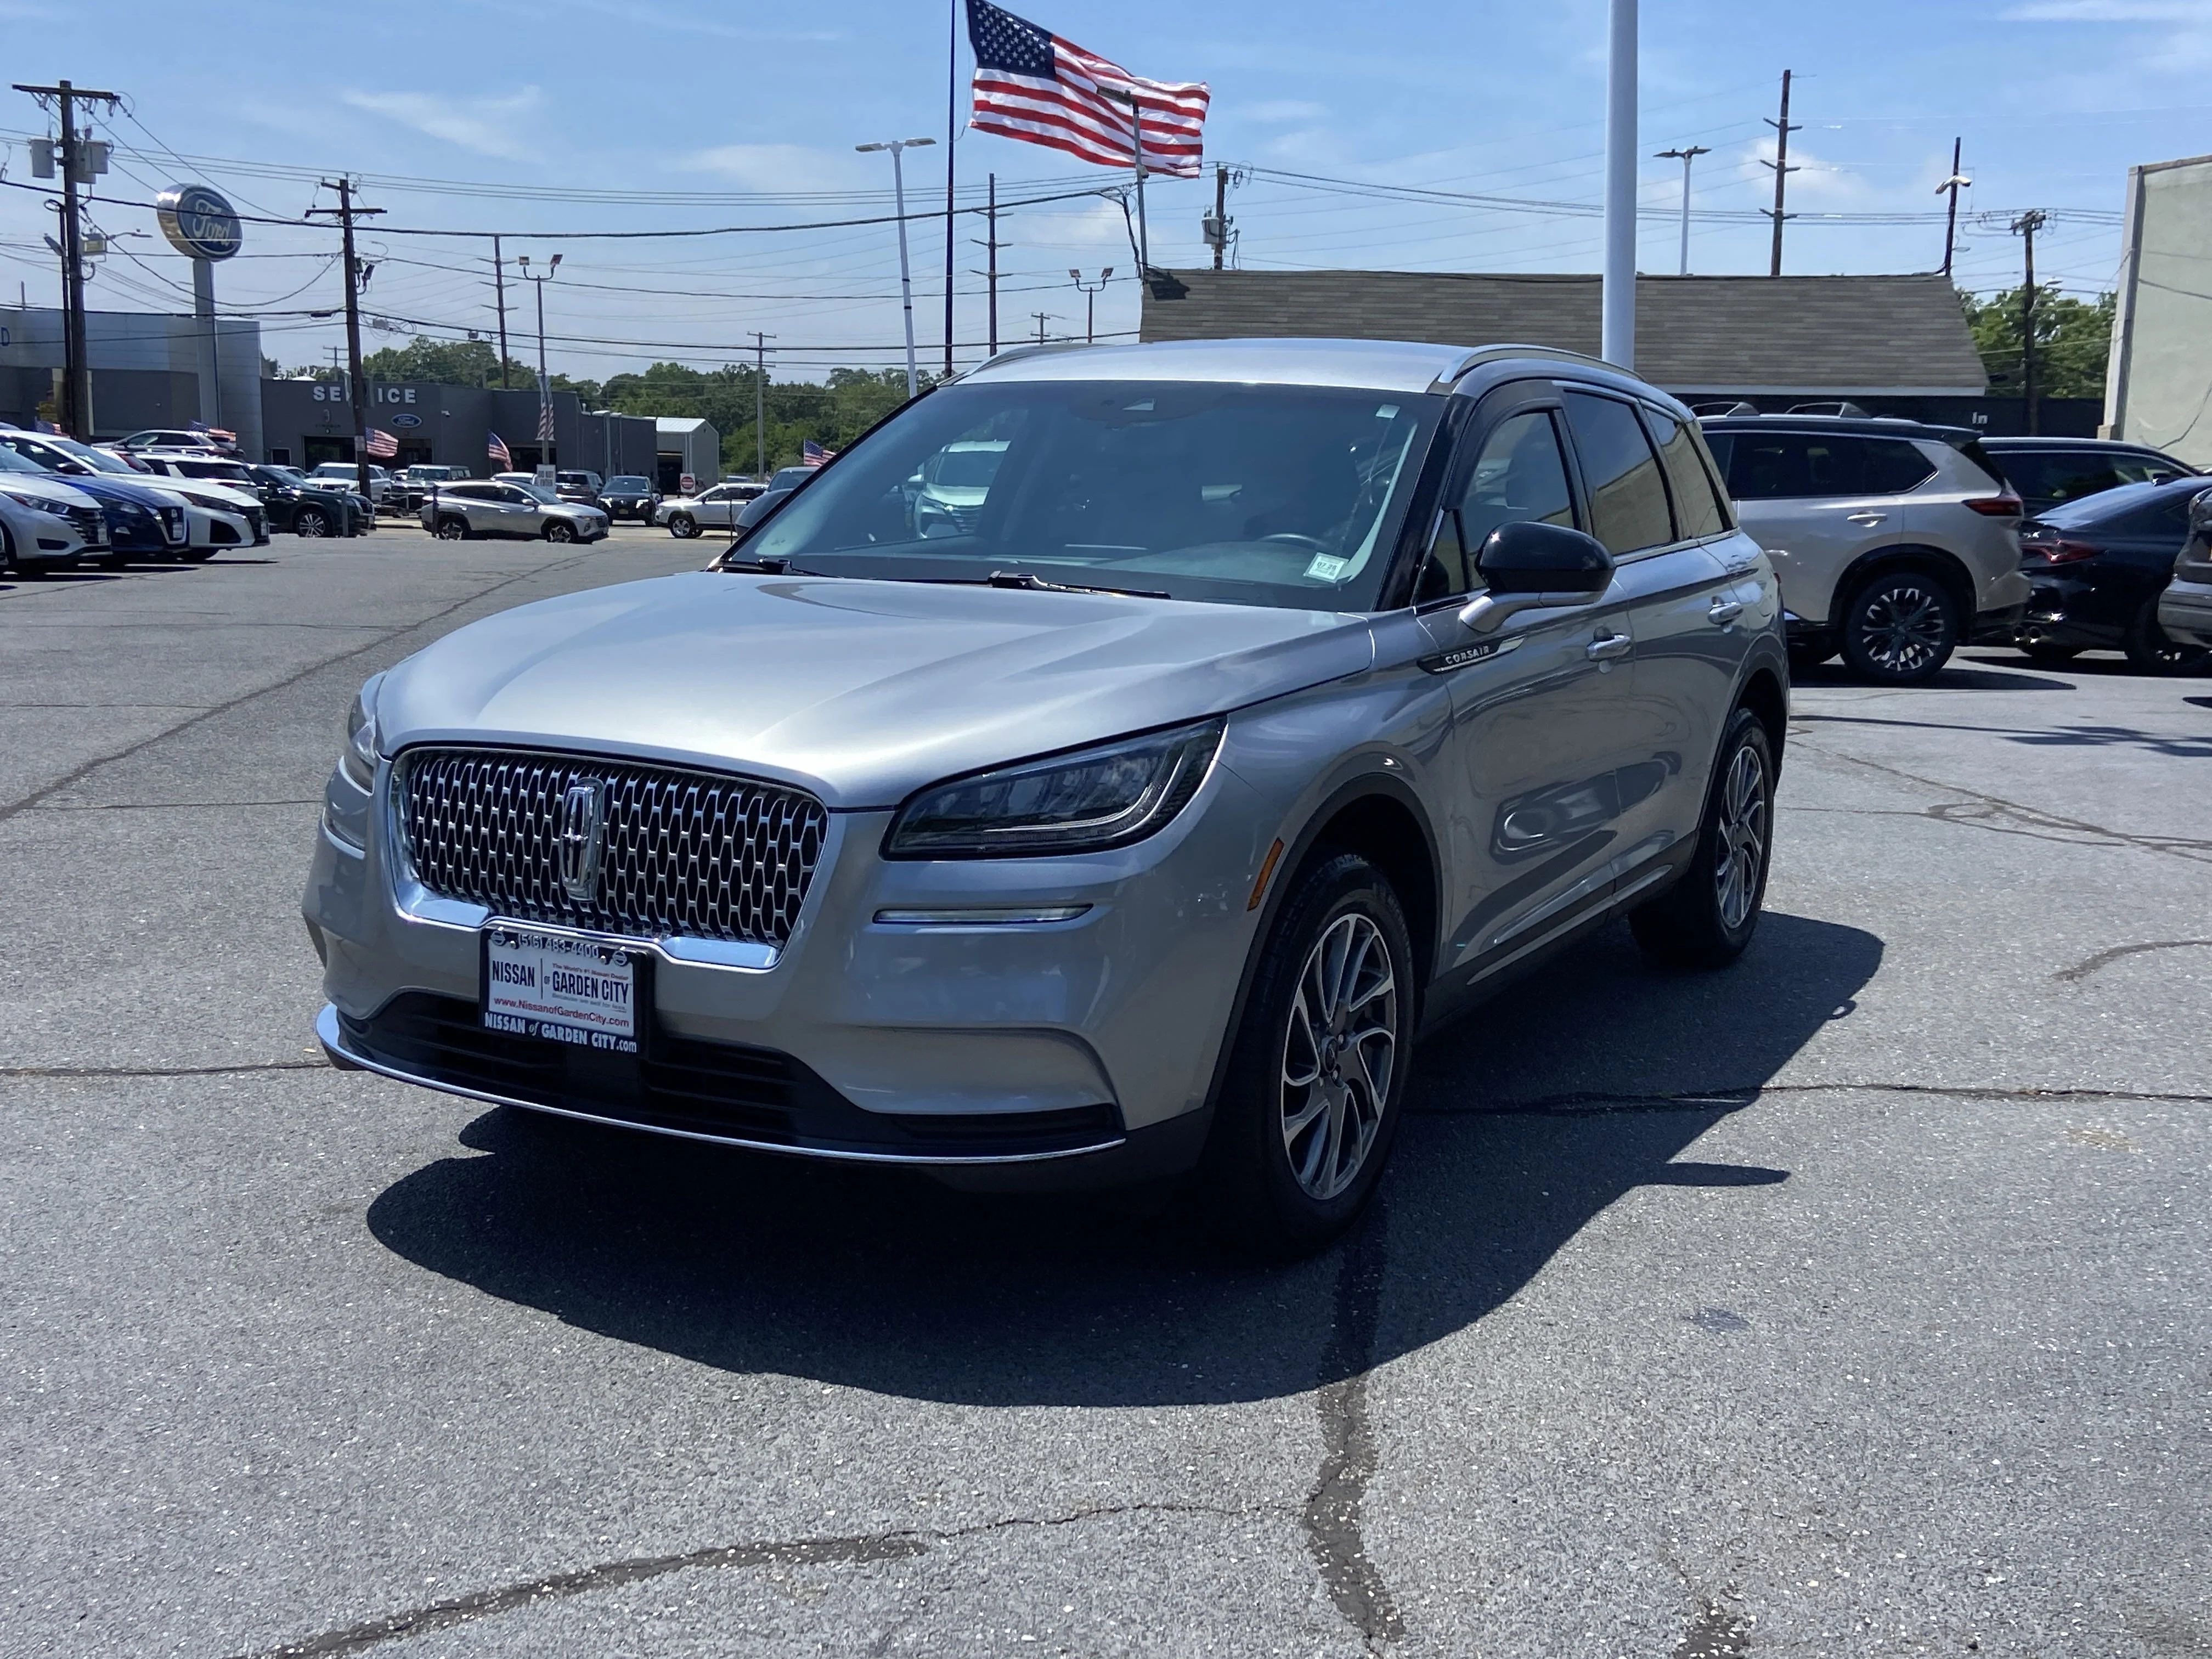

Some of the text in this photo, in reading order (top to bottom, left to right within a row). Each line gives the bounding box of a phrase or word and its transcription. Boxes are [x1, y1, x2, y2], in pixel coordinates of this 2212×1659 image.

[193, 199, 232, 246] Ford
[313, 386, 416, 404] SEICE
[1972, 411, 1988, 424] In
[1445, 645, 1490, 664] CORSAIR
[492, 961, 535, 988] NISSAN
[552, 970, 599, 998] GARDEN
[601, 979, 629, 1004] CITY
[494, 997, 629, 1028] www.NissanofGardenCity.com
[484, 1012, 637, 1053] NISSAN of GARDEN CITY.com
